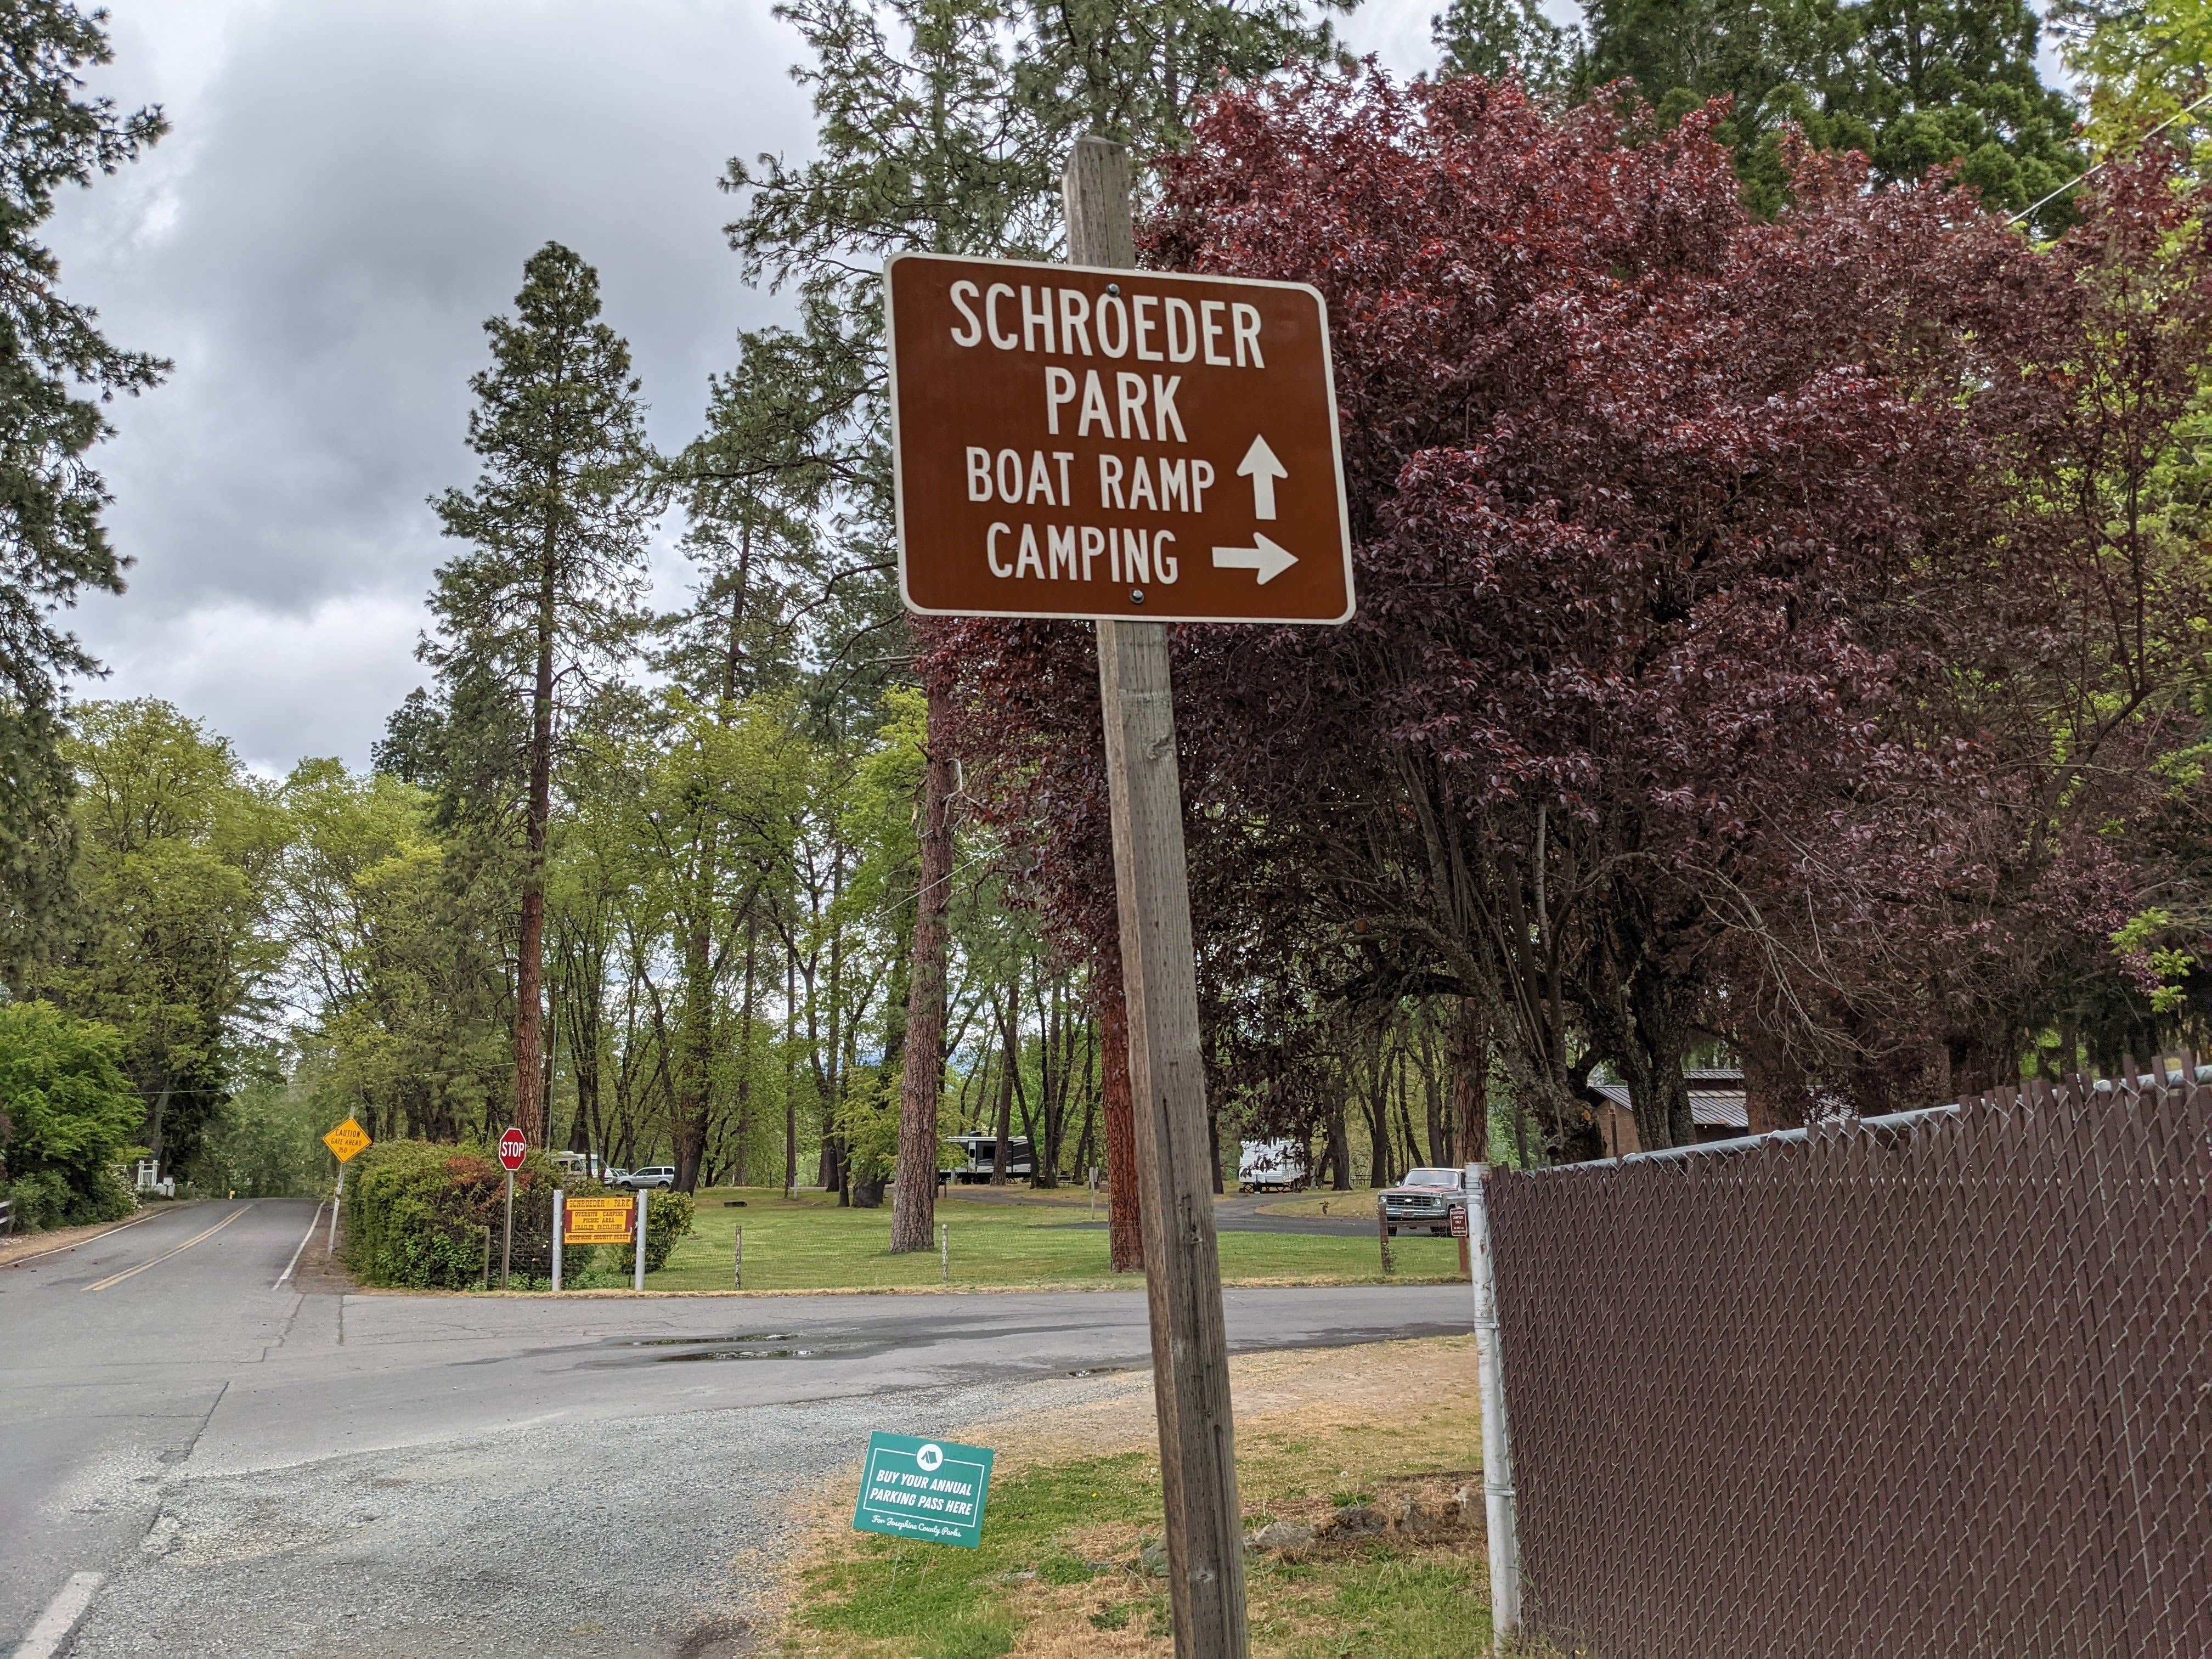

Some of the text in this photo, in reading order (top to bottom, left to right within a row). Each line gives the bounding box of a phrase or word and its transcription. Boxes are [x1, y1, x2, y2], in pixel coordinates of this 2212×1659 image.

[950, 280, 1265, 369] SCHROEDER
[1044, 365, 1188, 443] PARK
[966, 445, 1216, 514] BOAT RAMP
[987, 522, 1179, 585] CAMPING
[336, 1129, 360, 1138] CAUTION
[501, 1141, 524, 1158] STOP
[569, 1199, 630, 1207] SCHROEDER PARK
[876, 1469, 972, 1496] BUY YOUR ANNUAL
[870, 1487, 973, 1515] PARKING PASS HERE
[871, 1515, 962, 1537] For Josephine County Parks
